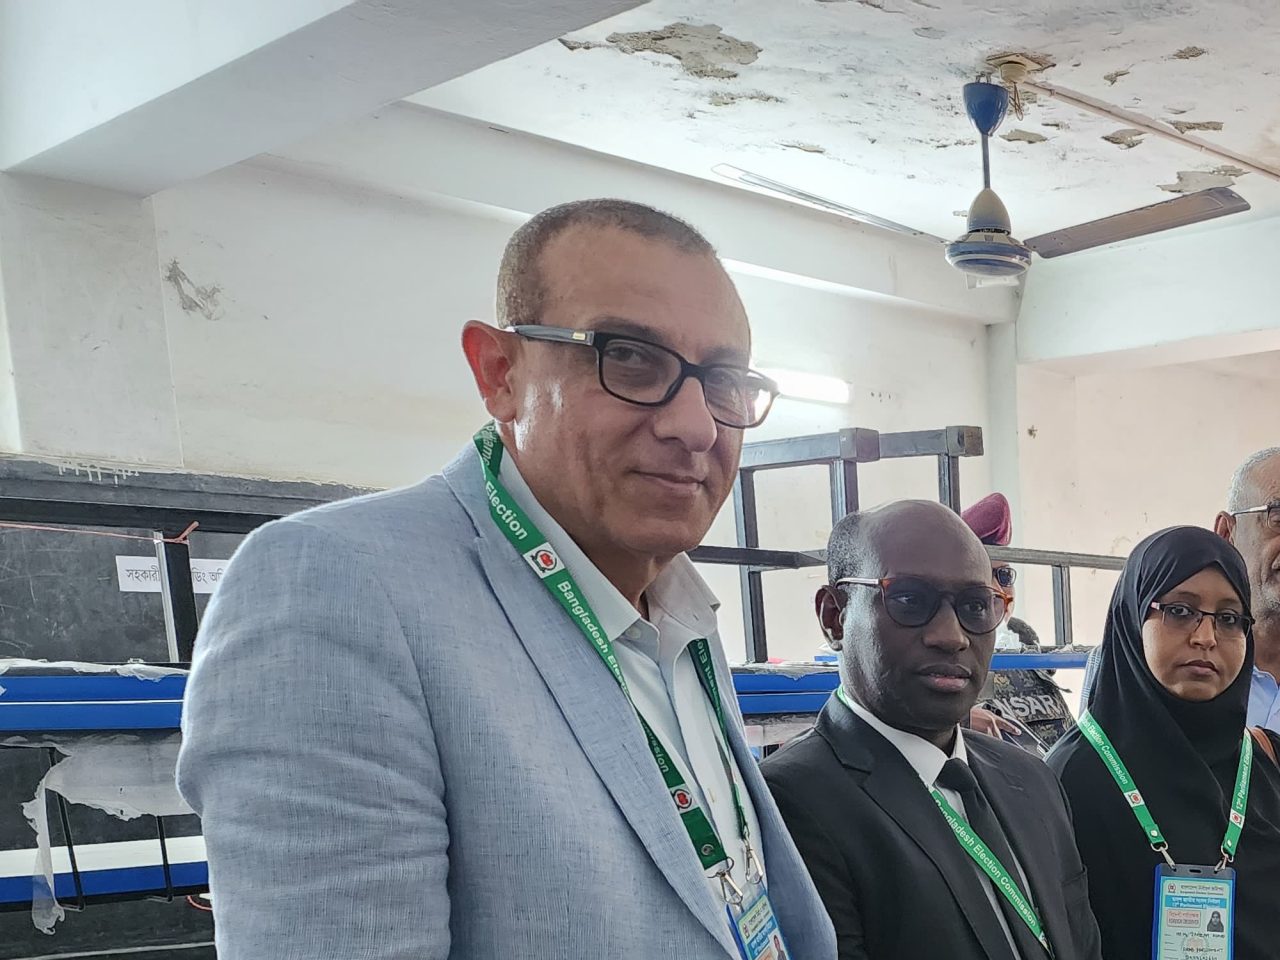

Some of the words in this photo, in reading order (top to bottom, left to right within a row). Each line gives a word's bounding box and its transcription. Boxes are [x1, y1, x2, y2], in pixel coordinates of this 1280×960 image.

[485, 480, 528, 540] Election
[125, 564, 160, 583] সহকারী
[557, 580, 609, 654] Bangladesh
[992, 694, 1062, 718] NSAR
[1101, 744, 1129, 785] Commission
[934, 799, 975, 847] gladesh
[973, 840, 1002, 879] Election
[1000, 875, 1037, 928] Commission
